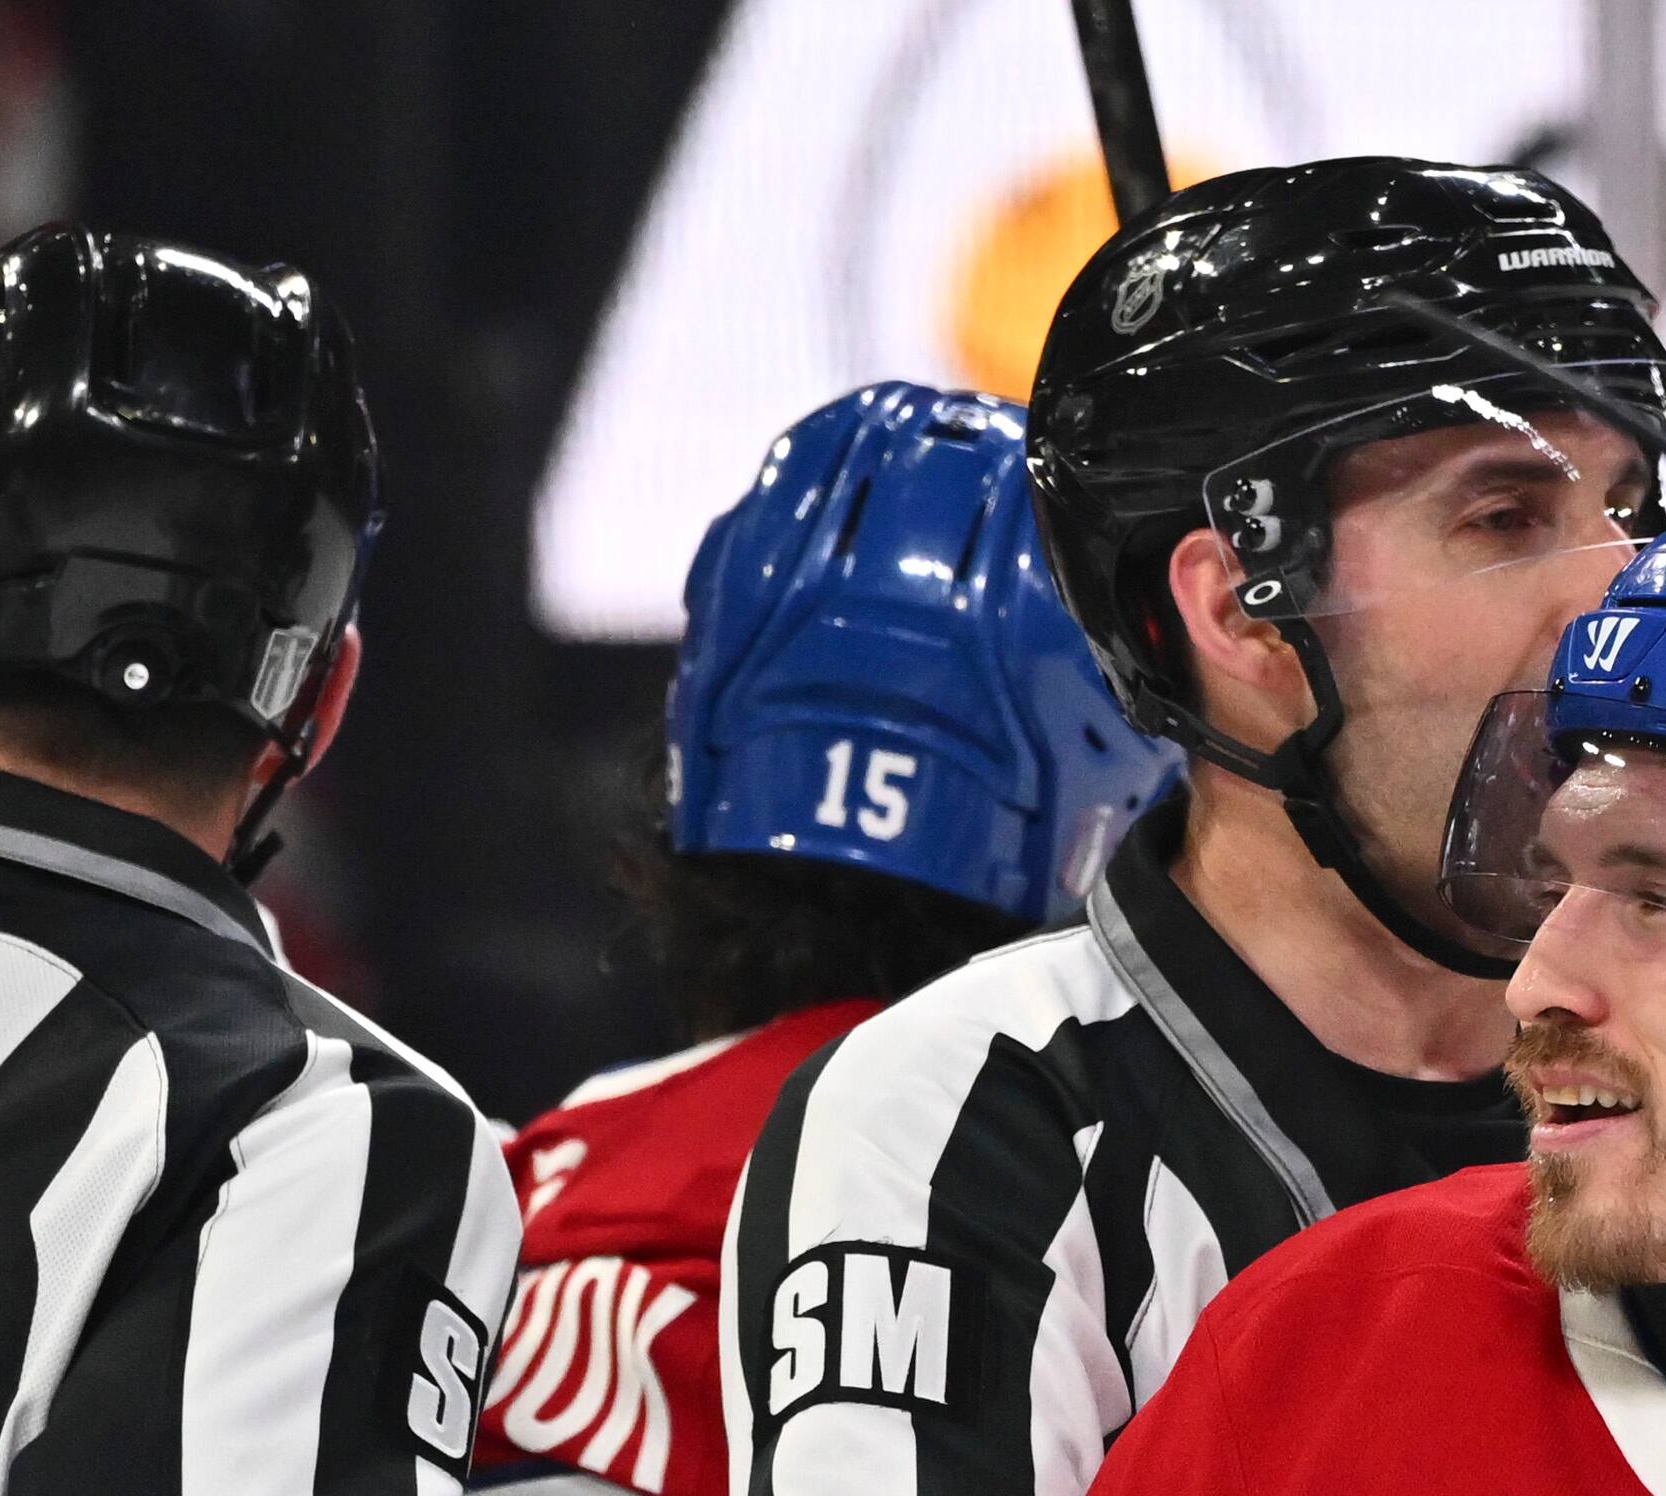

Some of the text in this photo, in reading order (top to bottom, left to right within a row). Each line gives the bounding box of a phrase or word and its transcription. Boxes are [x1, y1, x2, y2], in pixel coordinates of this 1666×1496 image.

[1497, 249, 1616, 272] WARRIOR
[815, 739, 918, 842] 15
[406, 1298, 481, 1460] S
[768, 1252, 952, 1417] SM
